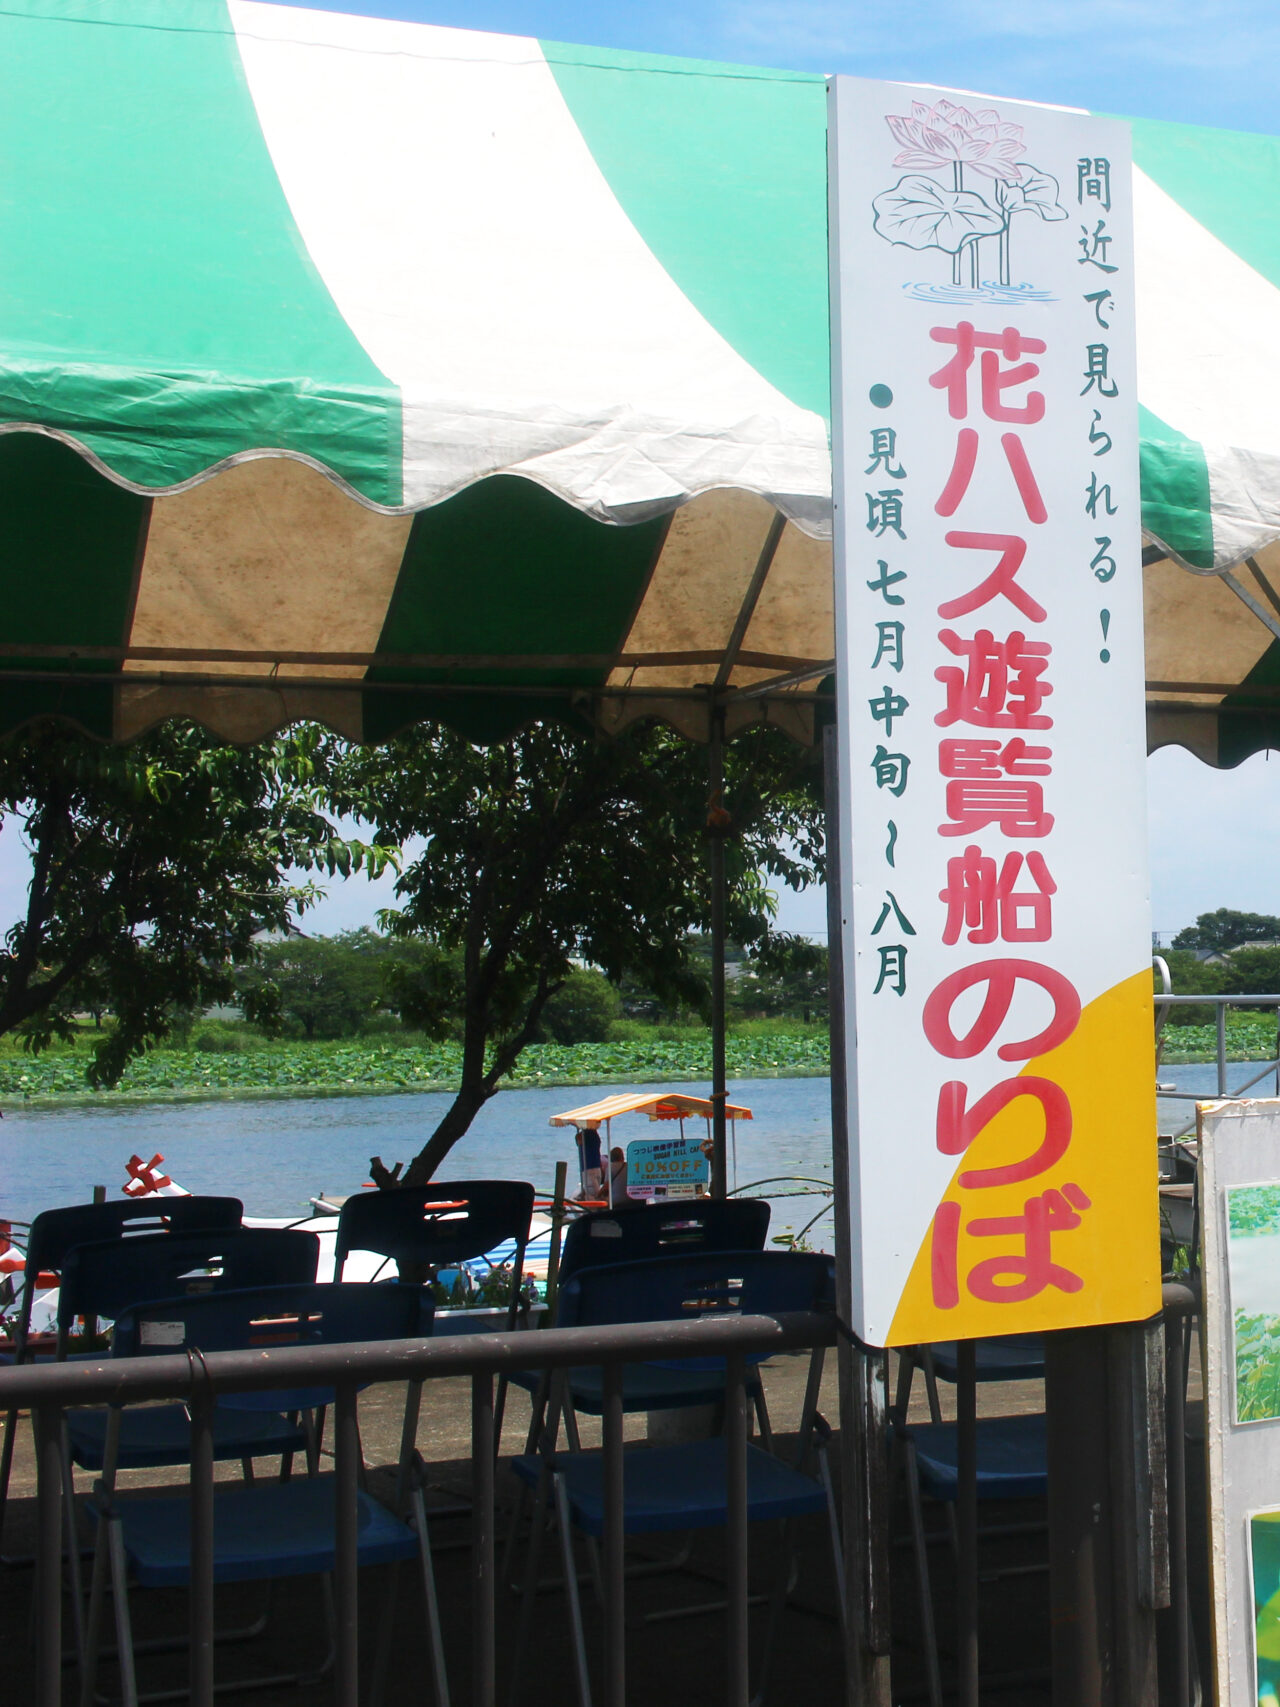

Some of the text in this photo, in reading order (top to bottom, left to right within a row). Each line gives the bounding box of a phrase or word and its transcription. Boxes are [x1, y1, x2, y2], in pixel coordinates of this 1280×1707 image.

[1075, 156, 1119, 665] 間近で見られる!
[921, 320, 1092, 1311] 花ハス遊覧船のりば
